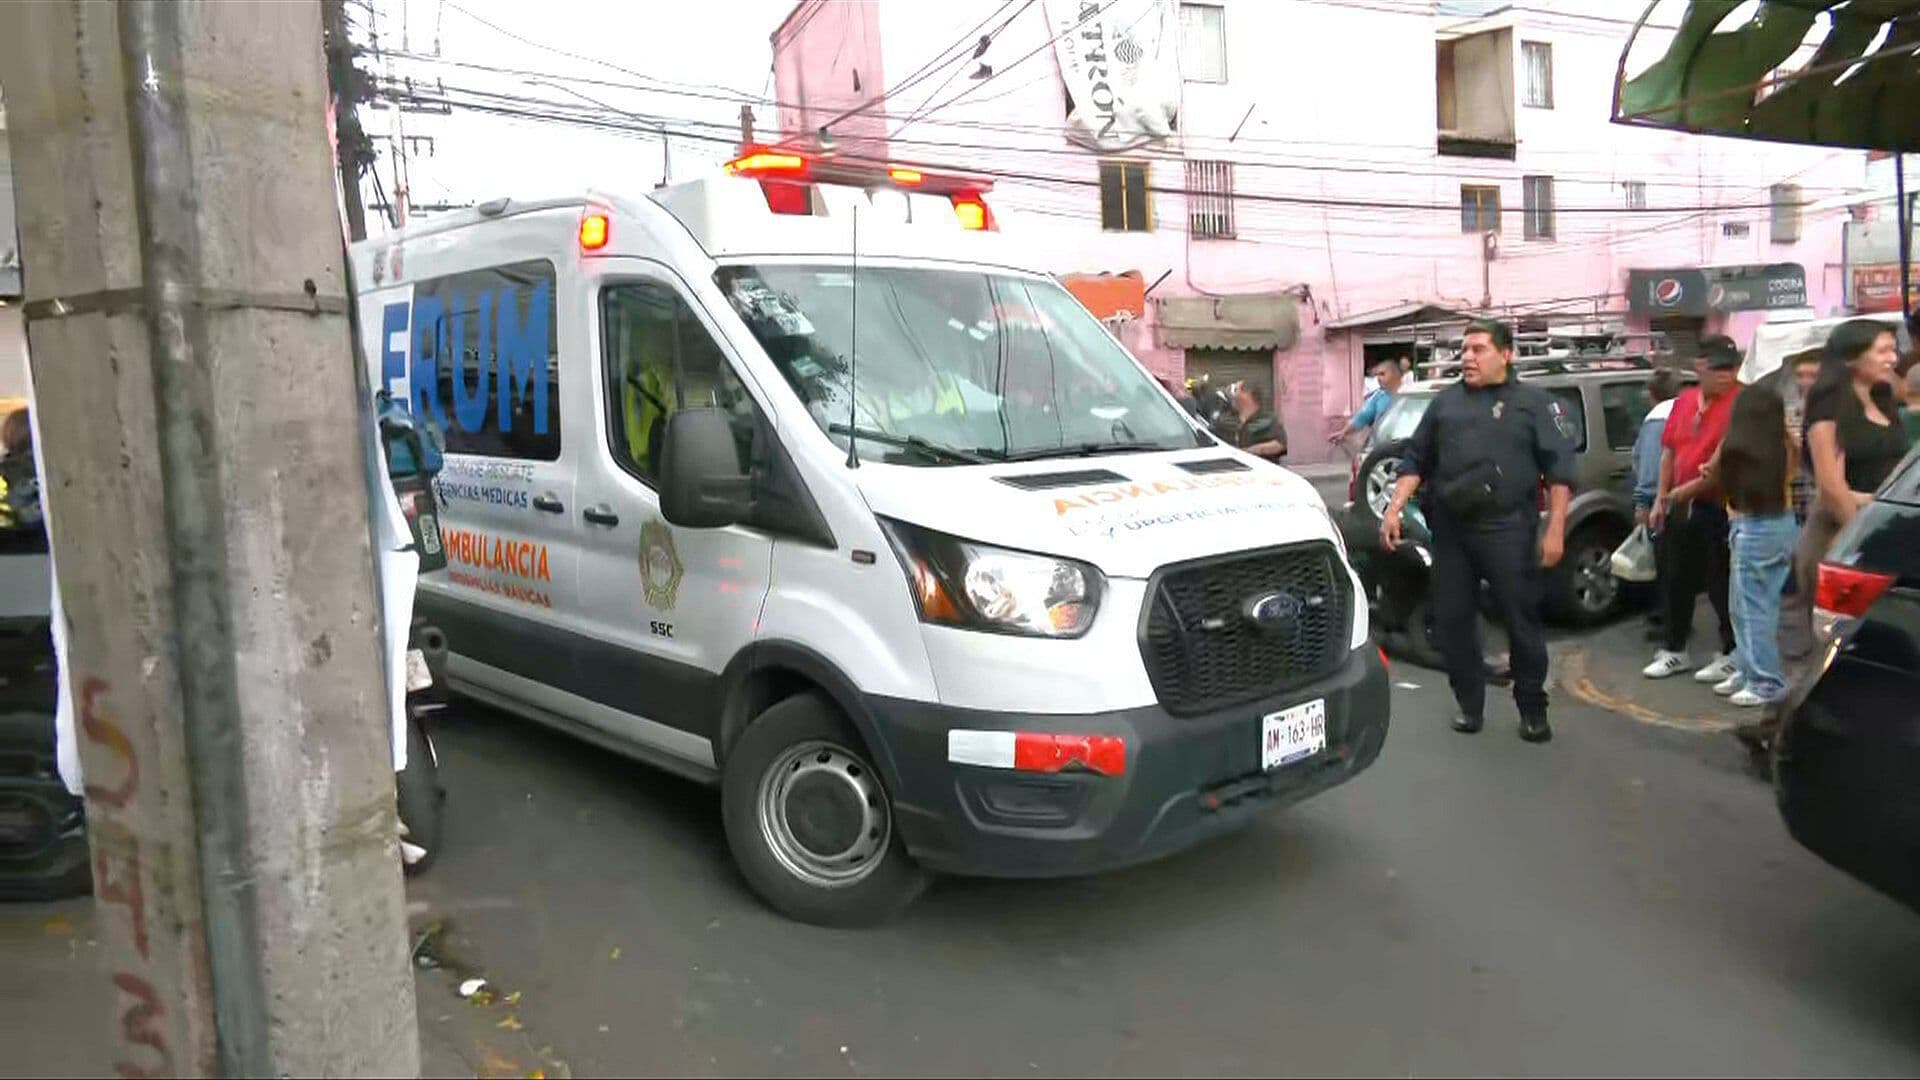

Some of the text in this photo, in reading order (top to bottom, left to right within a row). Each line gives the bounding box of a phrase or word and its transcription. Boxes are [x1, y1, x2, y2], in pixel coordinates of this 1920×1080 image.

[381, 278, 549, 434] ERUM
[481, 486, 528, 509] MEDICAS
[442, 527, 551, 583] AMBULANCIA
[650, 620, 674, 638] SSC
